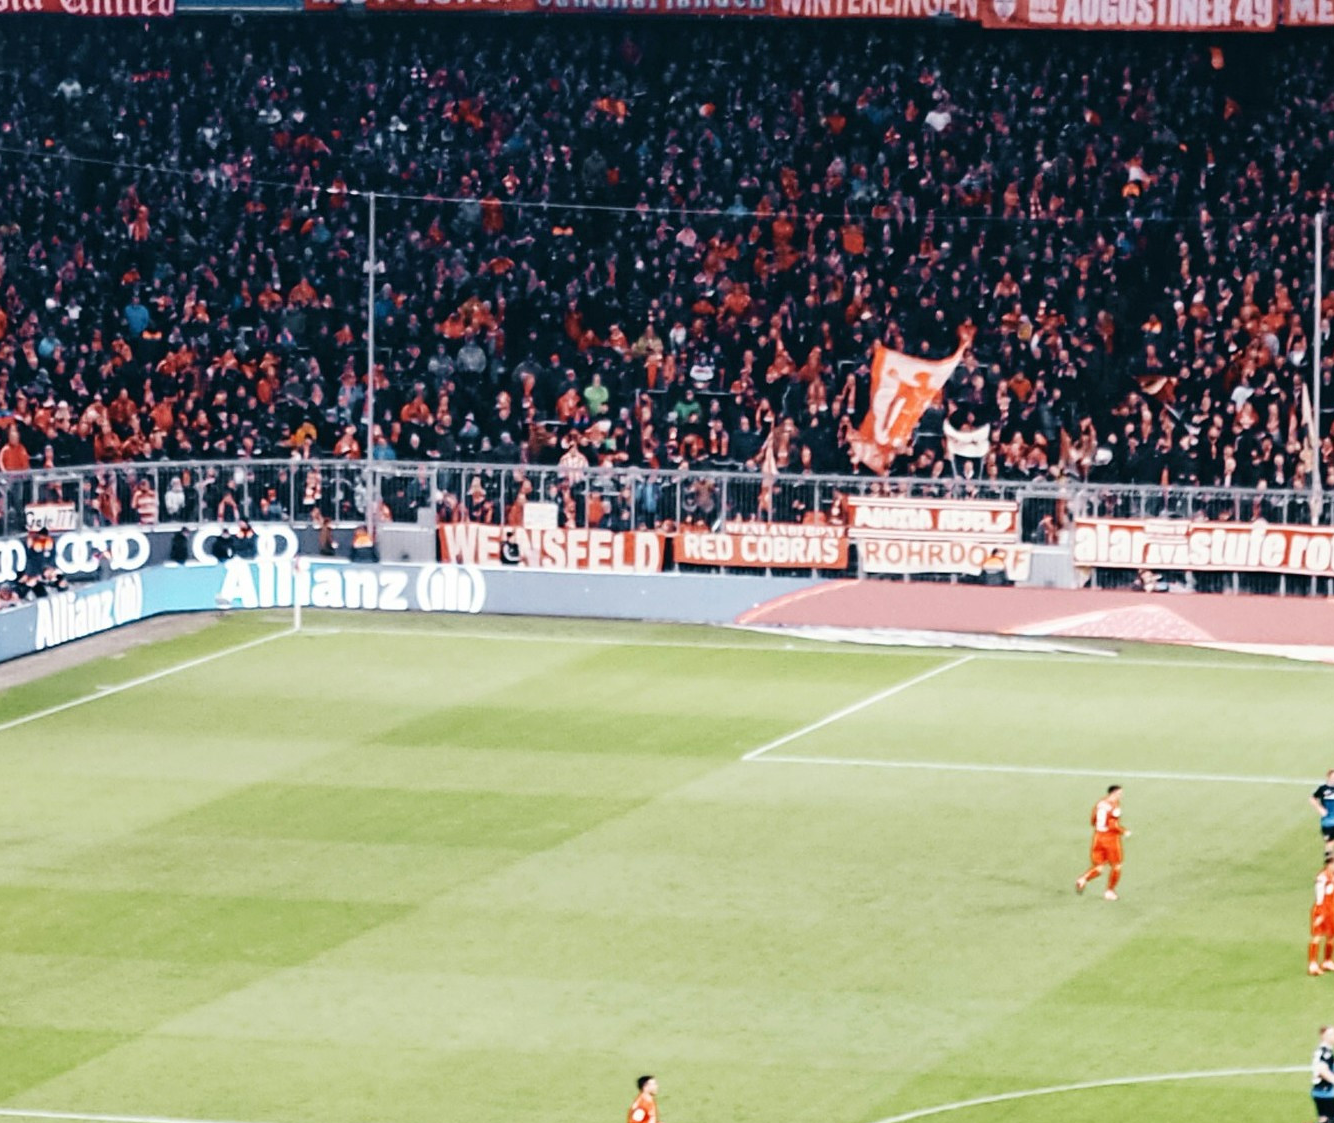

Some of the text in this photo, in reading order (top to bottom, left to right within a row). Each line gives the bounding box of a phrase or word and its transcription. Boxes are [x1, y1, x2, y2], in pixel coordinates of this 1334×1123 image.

[445, 523, 661, 573] WENSFELD
[683, 533, 840, 565] RED COBRAS
[220, 558, 409, 609] Allianz
[34, 586, 115, 651] Allianz
